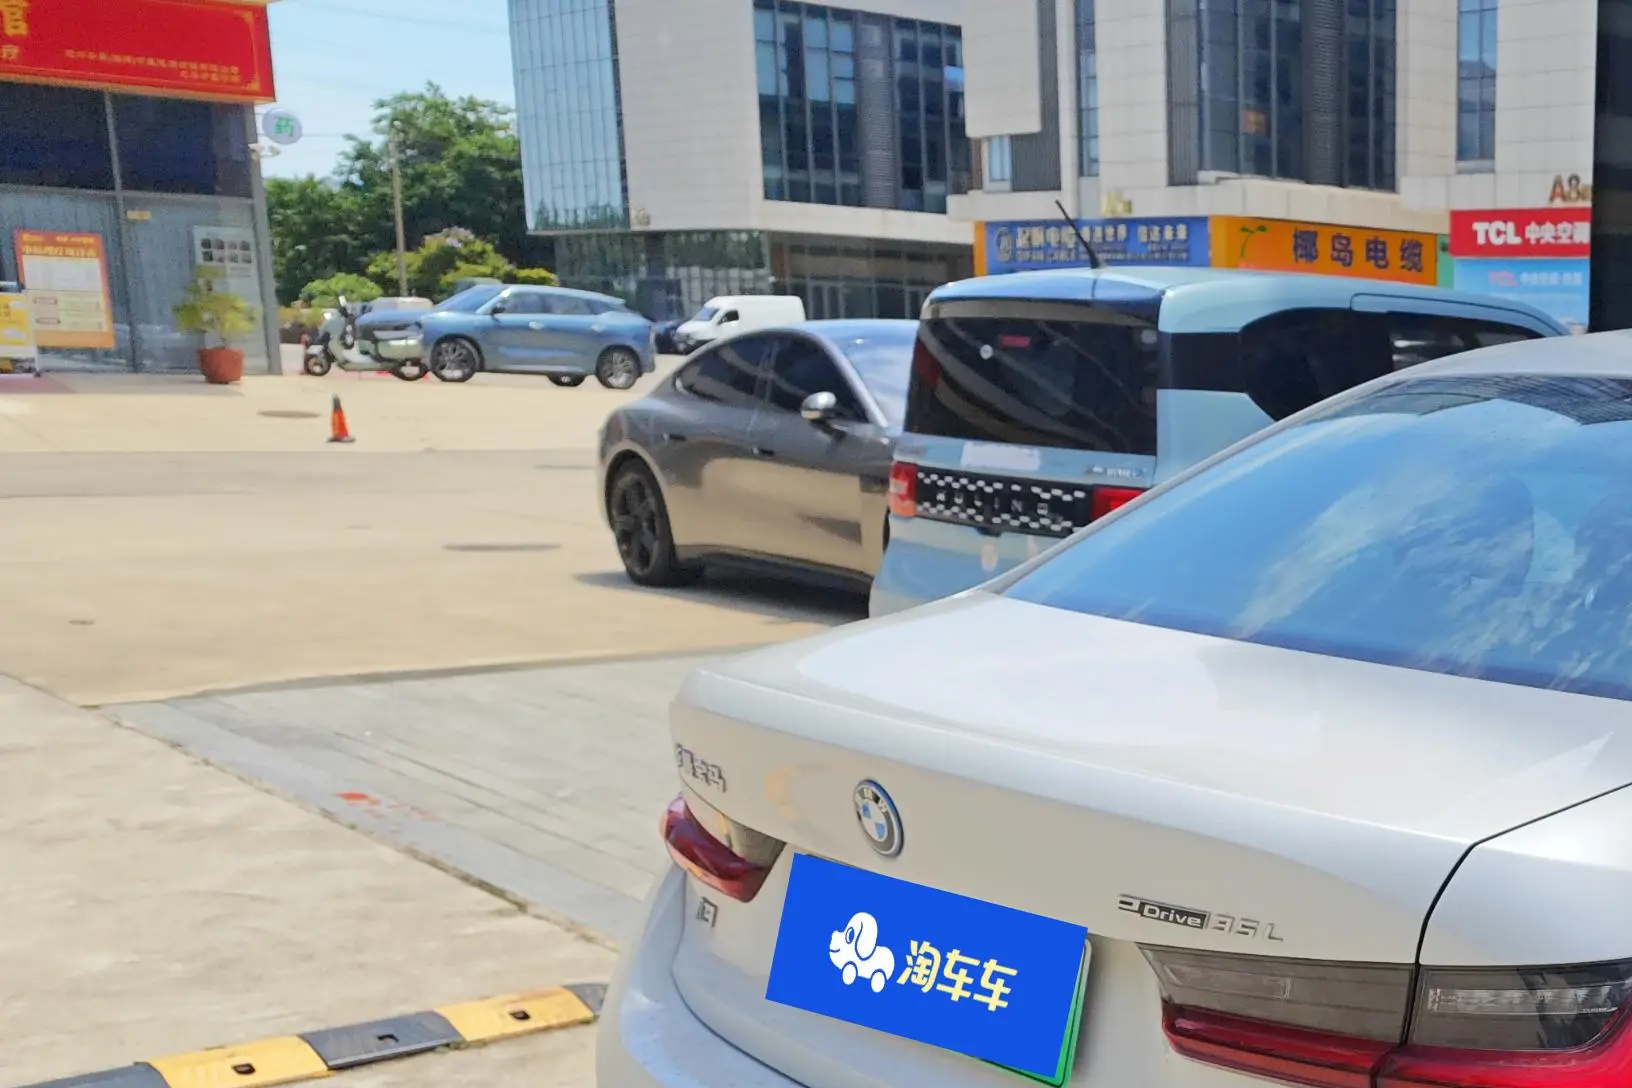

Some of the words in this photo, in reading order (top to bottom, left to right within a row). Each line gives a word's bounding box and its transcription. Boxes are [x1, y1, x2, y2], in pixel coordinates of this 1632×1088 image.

[1293, 226, 1424, 273] 椰岛电缆
[1472, 220, 1523, 246] TCL
